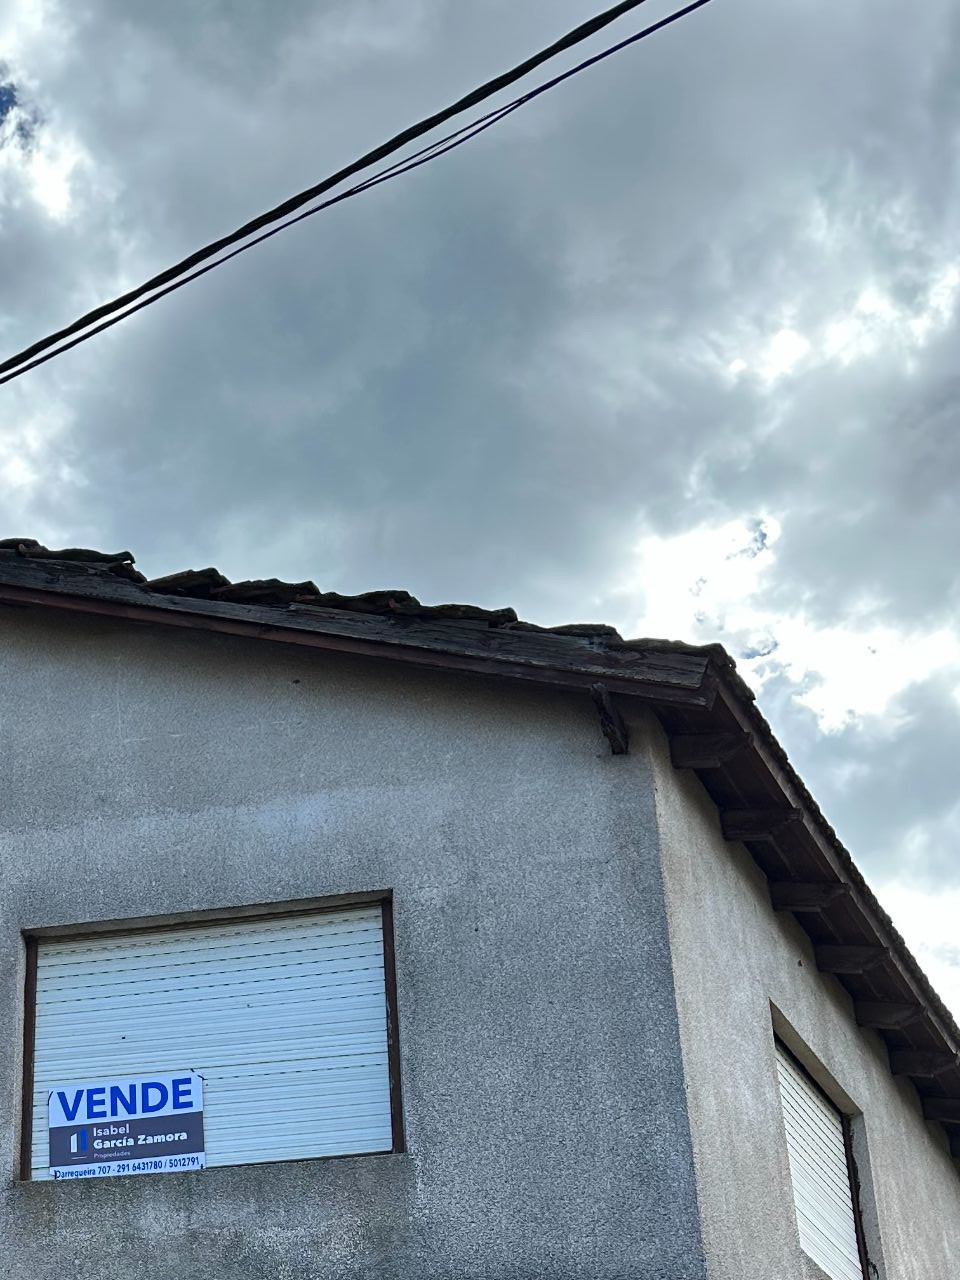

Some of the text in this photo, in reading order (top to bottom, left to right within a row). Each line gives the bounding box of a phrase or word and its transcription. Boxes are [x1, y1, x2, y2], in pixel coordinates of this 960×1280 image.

[57, 1077, 193, 1121] VENDE
[93, 1123, 130, 1137] Isabel
[93, 1131, 188, 1149] García Zamora
[97, 1165, 111, 1175] 707
[117, 1163, 130, 1173] 291
[132, 1160, 163, 1172] 6431780
[169, 1156, 200, 1168] 5012791
